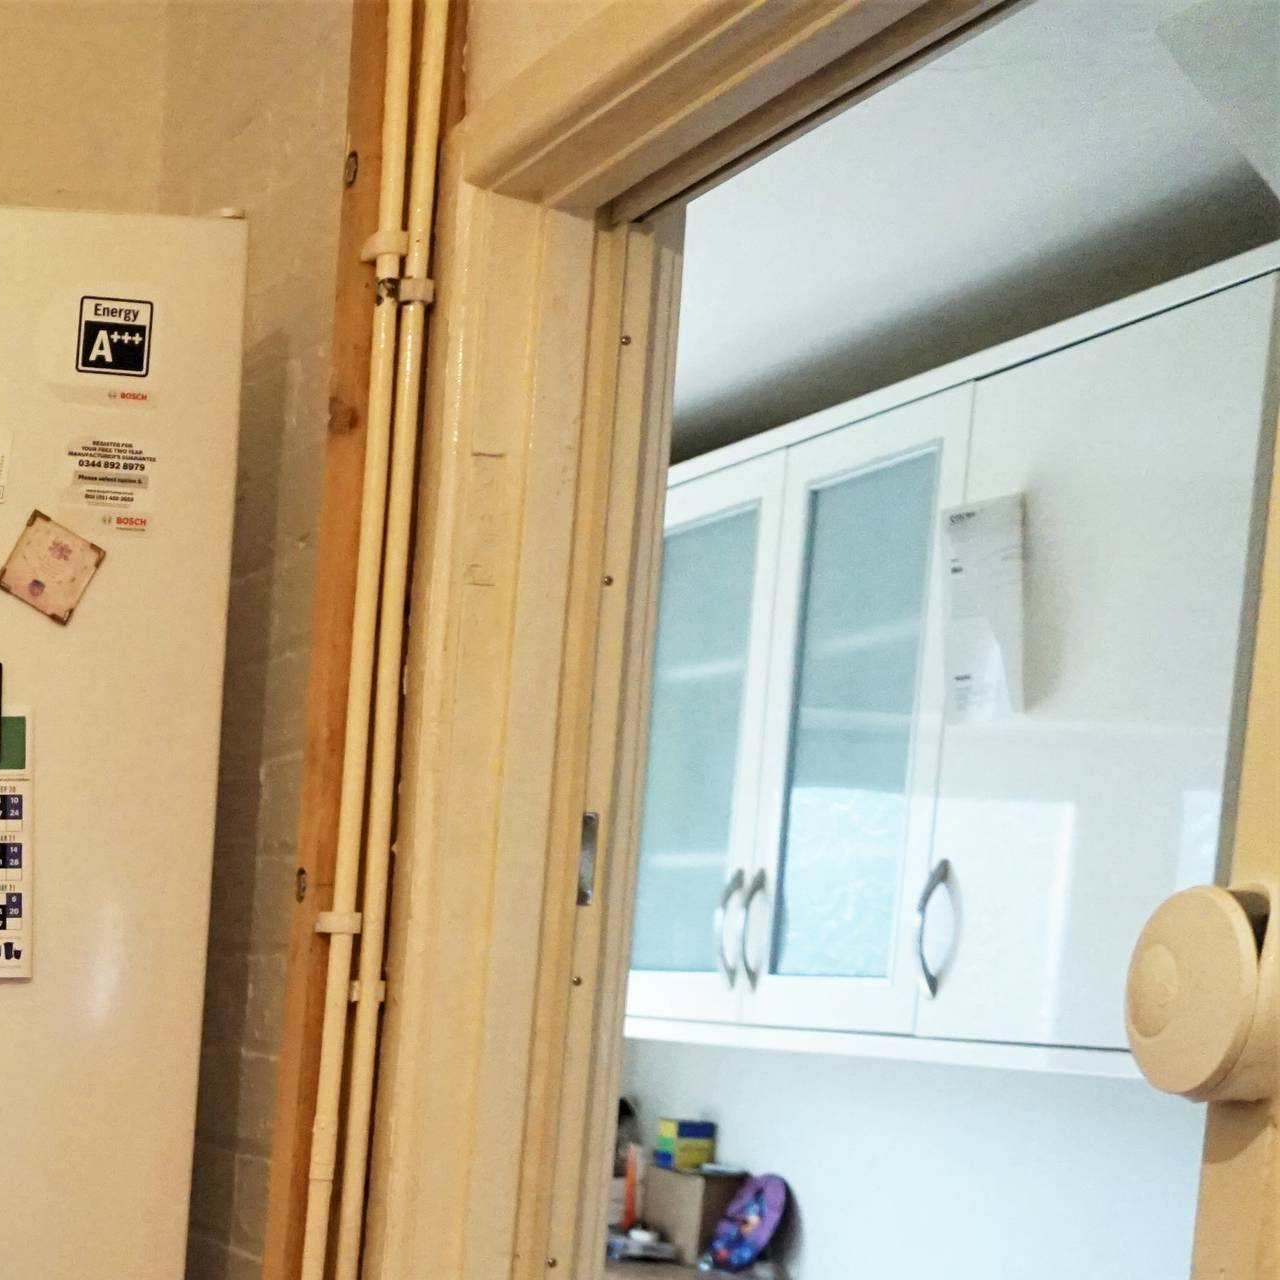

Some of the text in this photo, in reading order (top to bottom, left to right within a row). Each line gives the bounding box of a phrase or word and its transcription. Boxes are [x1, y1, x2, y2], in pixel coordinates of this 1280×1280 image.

[94, 303, 140, 322] Energy
[89, 329, 143, 362] A+++
[120, 392, 148, 400] BOSCH
[78, 459, 145, 471] 0344 892 8979
[116, 516, 147, 526] BOSCH
